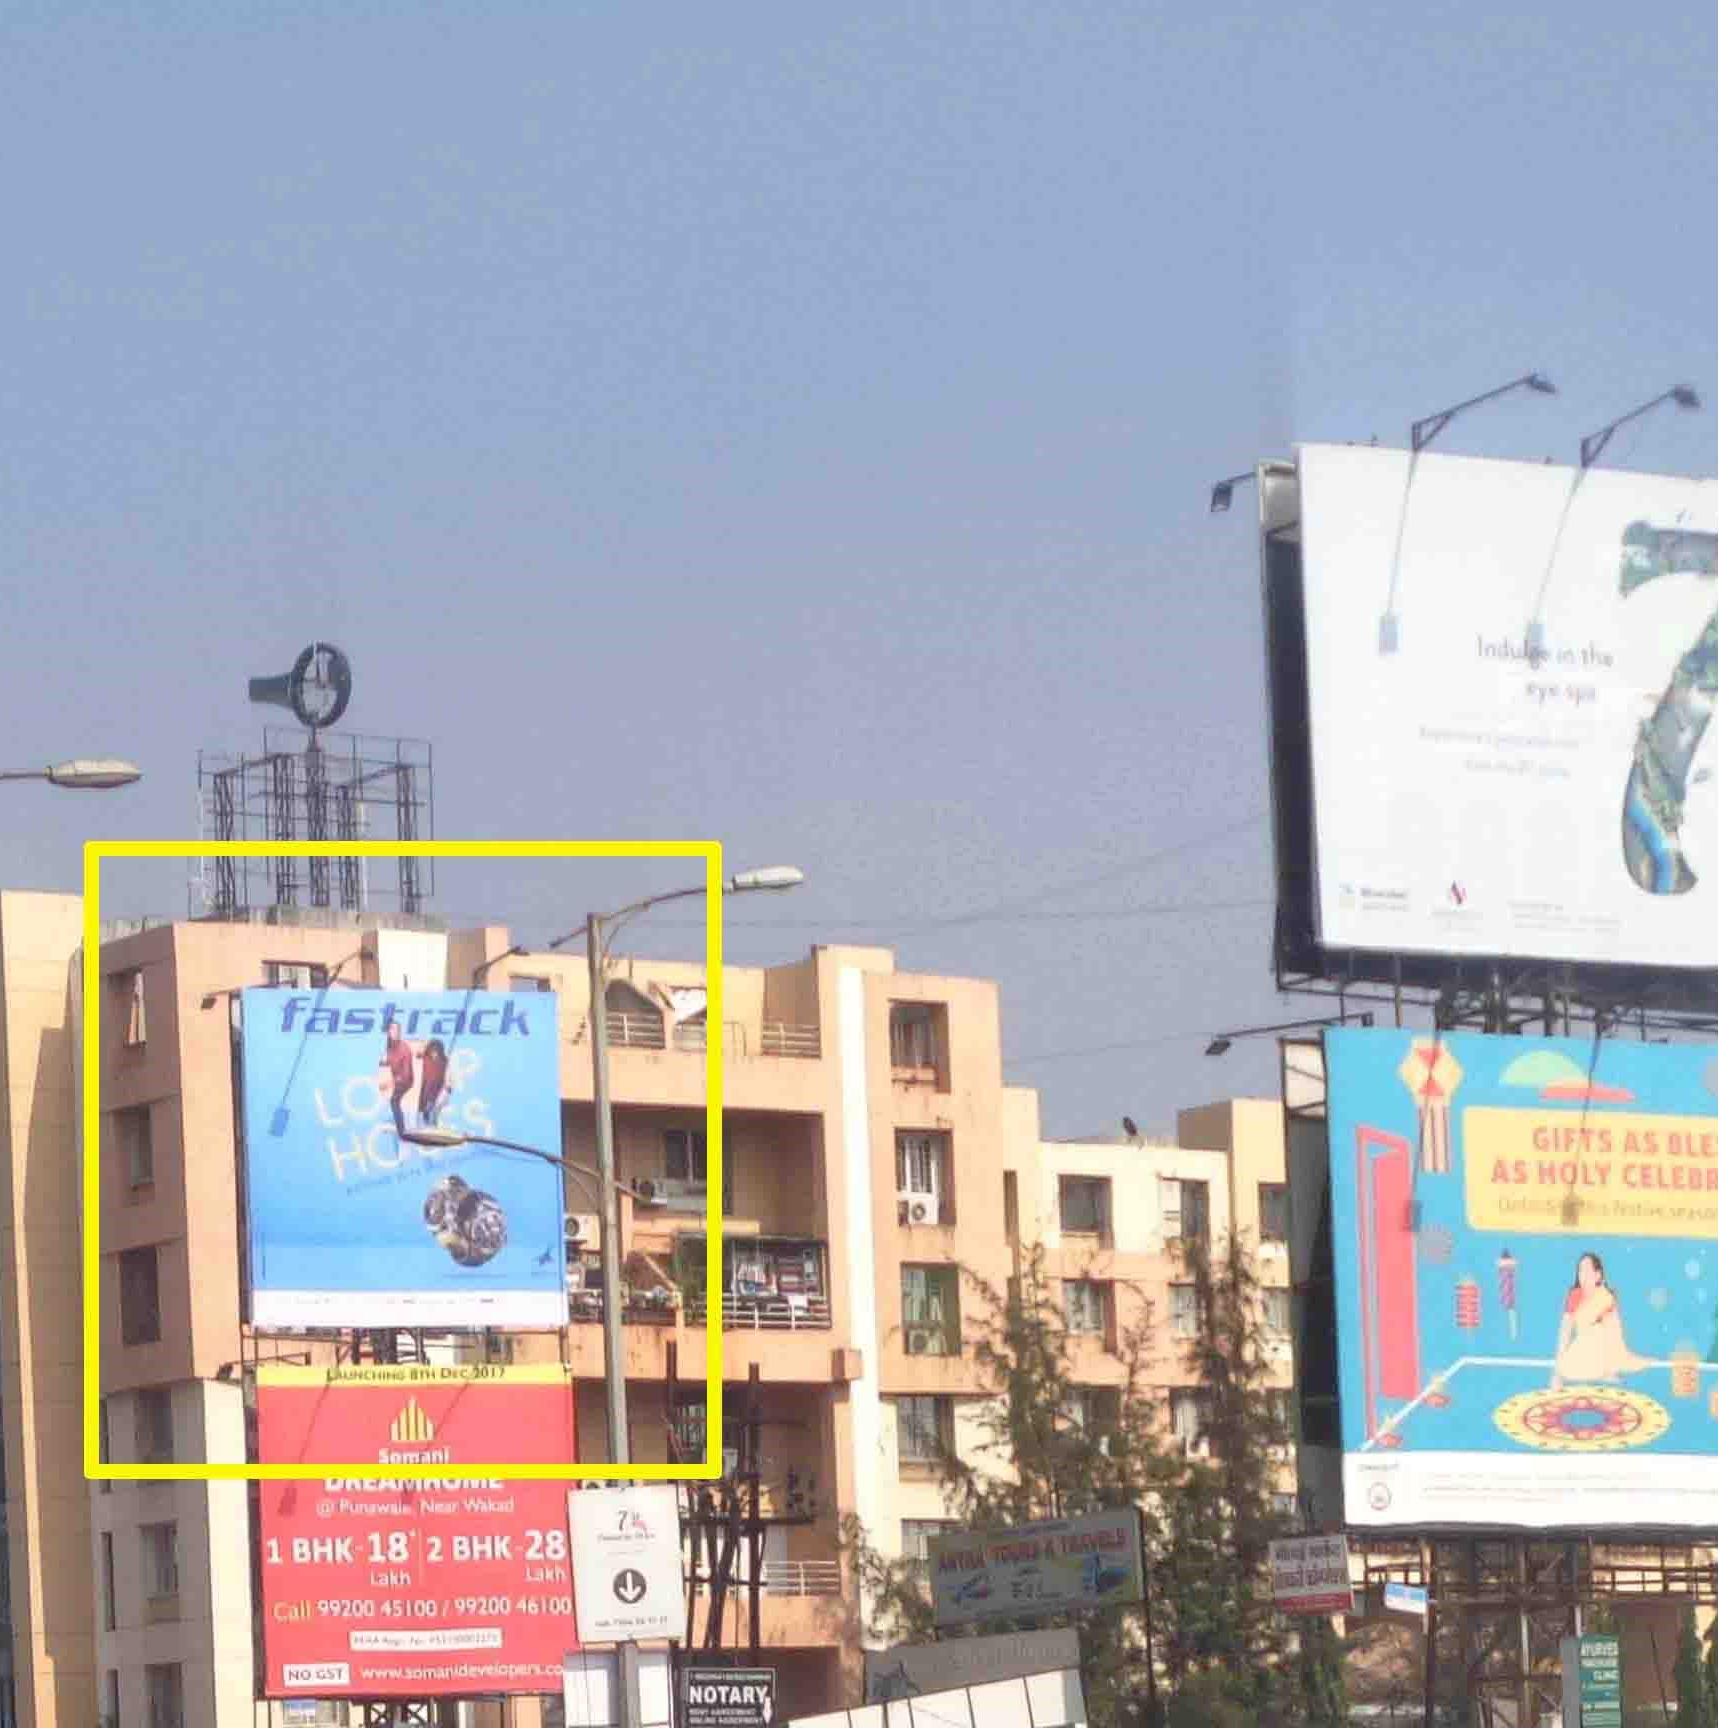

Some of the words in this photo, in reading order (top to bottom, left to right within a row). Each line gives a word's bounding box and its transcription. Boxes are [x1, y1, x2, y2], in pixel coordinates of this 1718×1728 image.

[1580, 639, 1614, 666] the
[281, 996, 530, 1037] fastrack
[1533, 1127, 1613, 1154] GIFTS
[1625, 1130, 1659, 1157] AS
[1491, 1159, 1529, 1186] AS
[1538, 1161, 1612, 1187] HOLY
[473, 1365, 506, 1380] 2017
[378, 1447, 450, 1465] Somani
[315, 1501, 334, 1518] @
[420, 1498, 458, 1515] Near
[266, 1538, 283, 1565] 1
[426, 1535, 444, 1562] 2
[370, 1569, 412, 1587] Lakh
[524, 1566, 568, 1583] Lakh
[272, 1599, 313, 1623] Call
[316, 1598, 375, 1619] 99200
[454, 1596, 511, 1617] 99200
[287, 1668, 312, 1683] NO
[316, 1666, 345, 1682] GST
[689, 1685, 769, 1704] NOTARY
